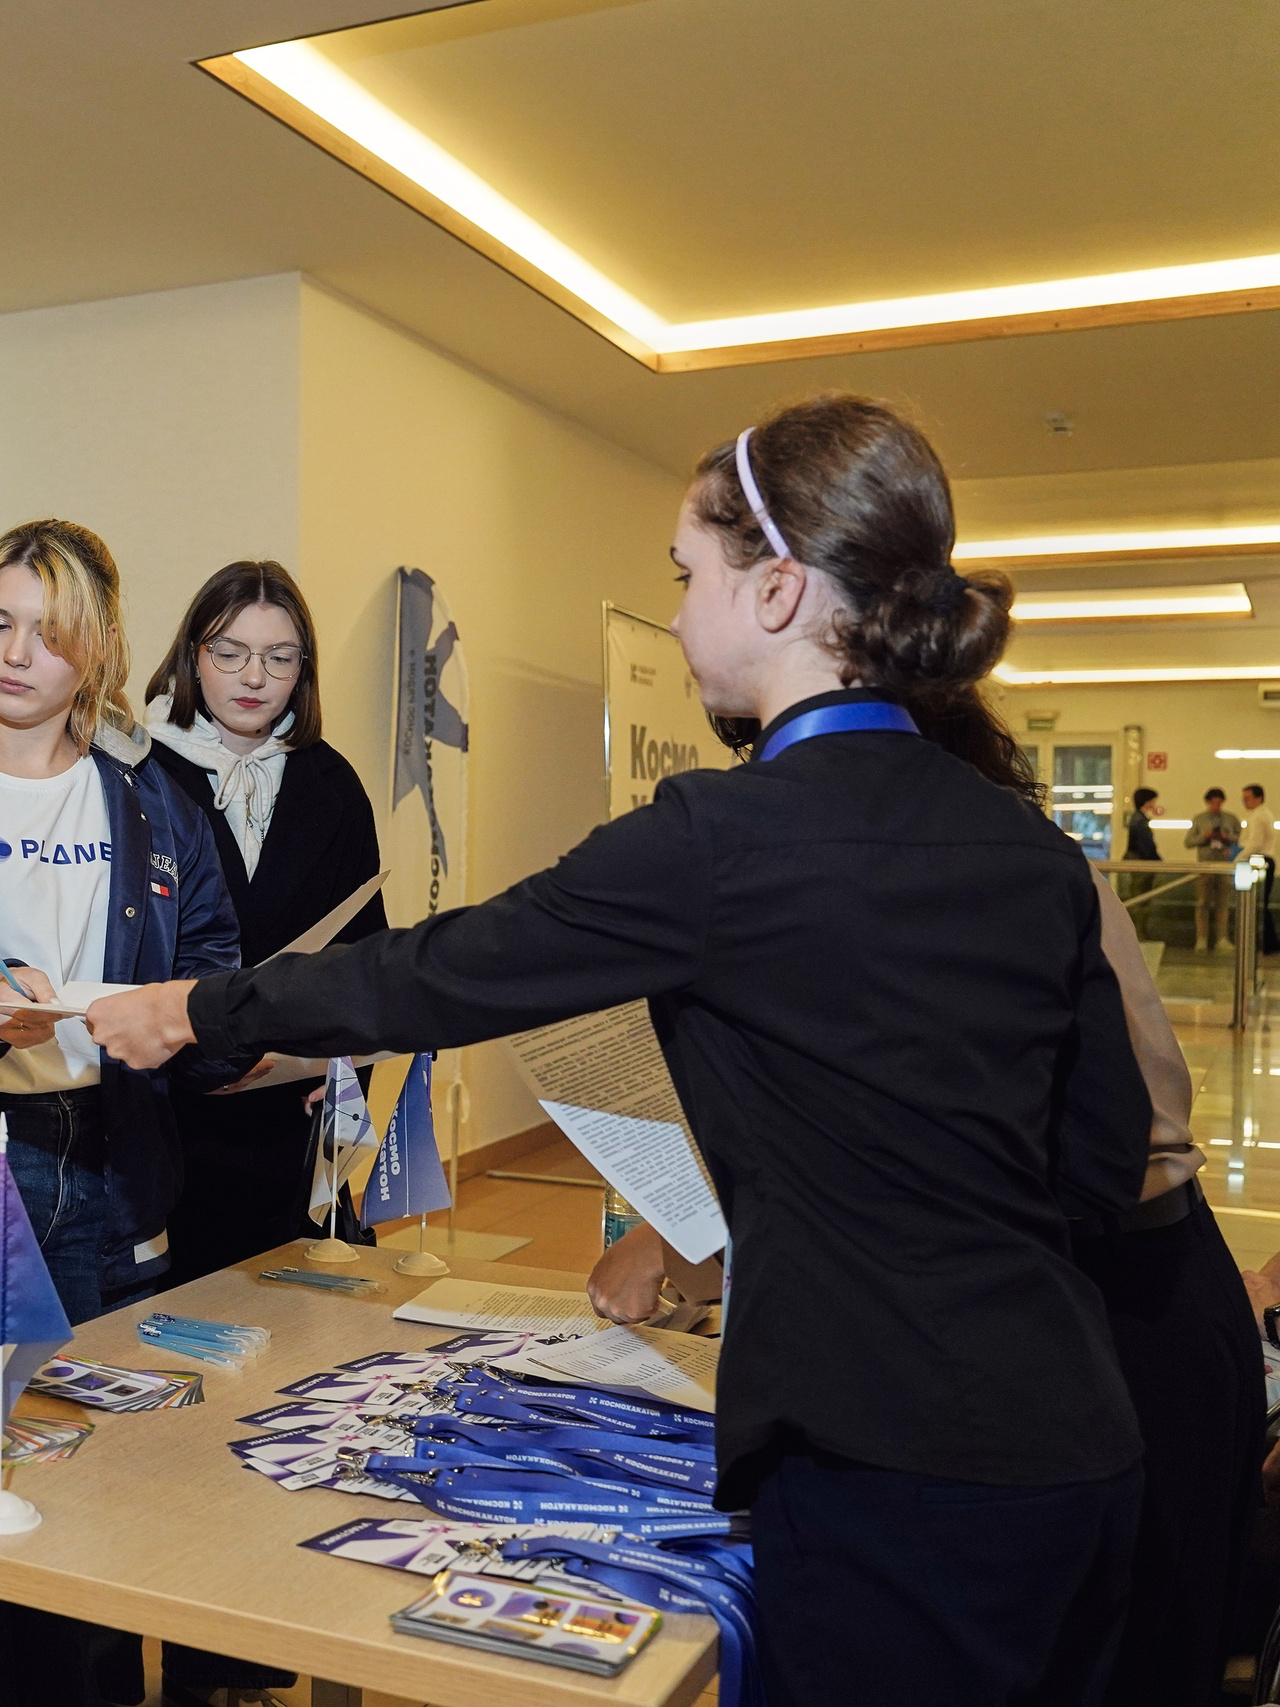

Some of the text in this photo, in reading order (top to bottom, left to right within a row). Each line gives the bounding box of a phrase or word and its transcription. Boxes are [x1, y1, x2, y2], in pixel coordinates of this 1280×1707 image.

[630, 723, 699, 781] Космо
[20, 839, 112, 865] PLANE
[517, 1389, 577, 1401] КОСМОХАКАТОН
[599, 1399, 661, 1418] КОСМОХАКАТОН
[576, 1408, 637, 1430] КОСМОХАКАТОН
[249, 1427, 311, 1446] УЧАСТНИК
[624, 1458, 690, 1482] КОСМОХАКАТОН
[446, 1504, 517, 1524] КОСМОХАКАТОН
[540, 1502, 617, 1513] КОСМОХАКАТОН
